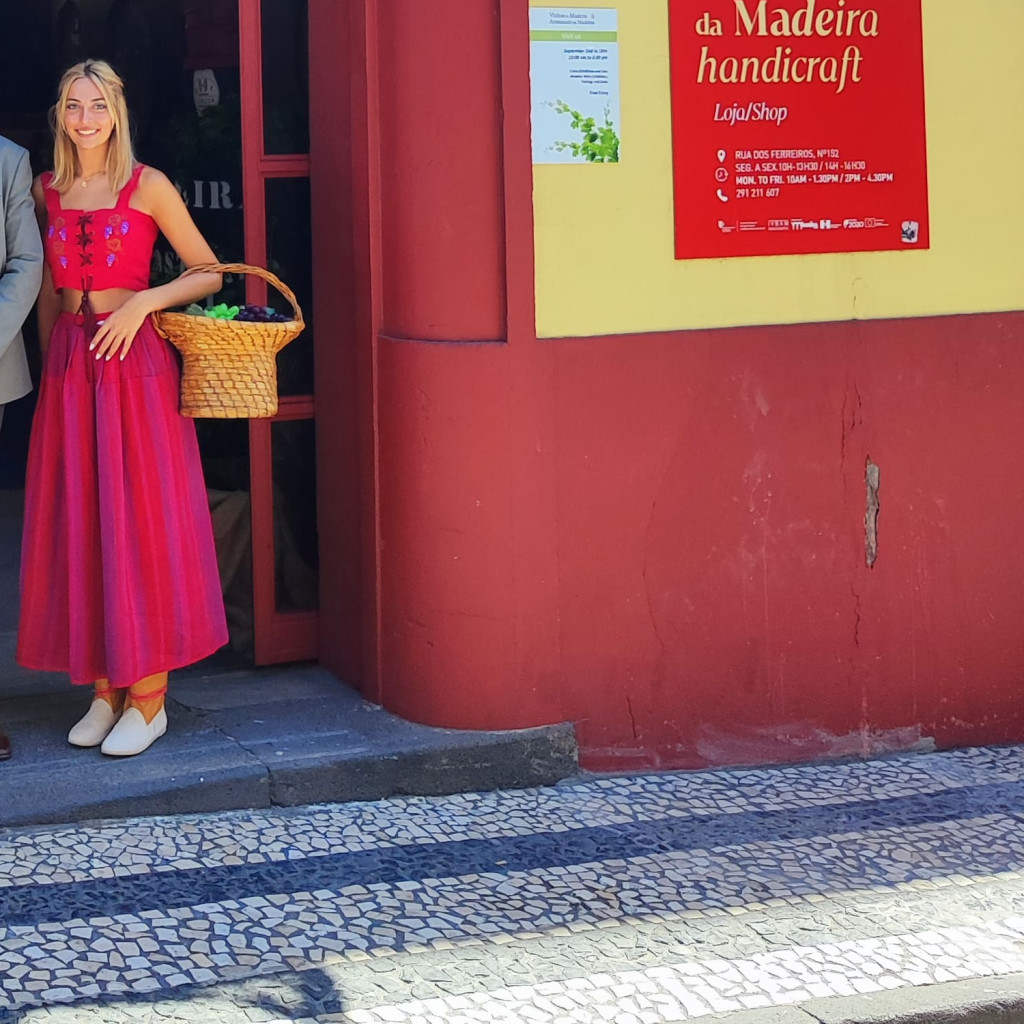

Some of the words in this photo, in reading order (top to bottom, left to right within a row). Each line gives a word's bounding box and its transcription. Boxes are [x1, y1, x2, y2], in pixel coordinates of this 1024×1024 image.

[695, 12, 723, 36] da
[696, 45, 863, 93] handicraft
[714, 102, 788, 126] Loja/Shop
[735, 150, 752, 159] RUA
[753, 150, 769, 159] DOS
[770, 149, 815, 159] FERREIROS,
[735, 163, 753, 172] SEG.
[755, 163, 761, 172] A
[736, 175, 757, 185] MON.
[758, 175, 768, 184] TO
[769, 175, 784, 184] FRI.
[786, 174, 807, 183] 10AM
[844, 173, 860, 183] 2PM
[867, 173, 893, 182] 4.30PM
[736, 188, 749, 198] 291
[751, 188, 763, 198] 211
[766, 188, 780, 197] 607
